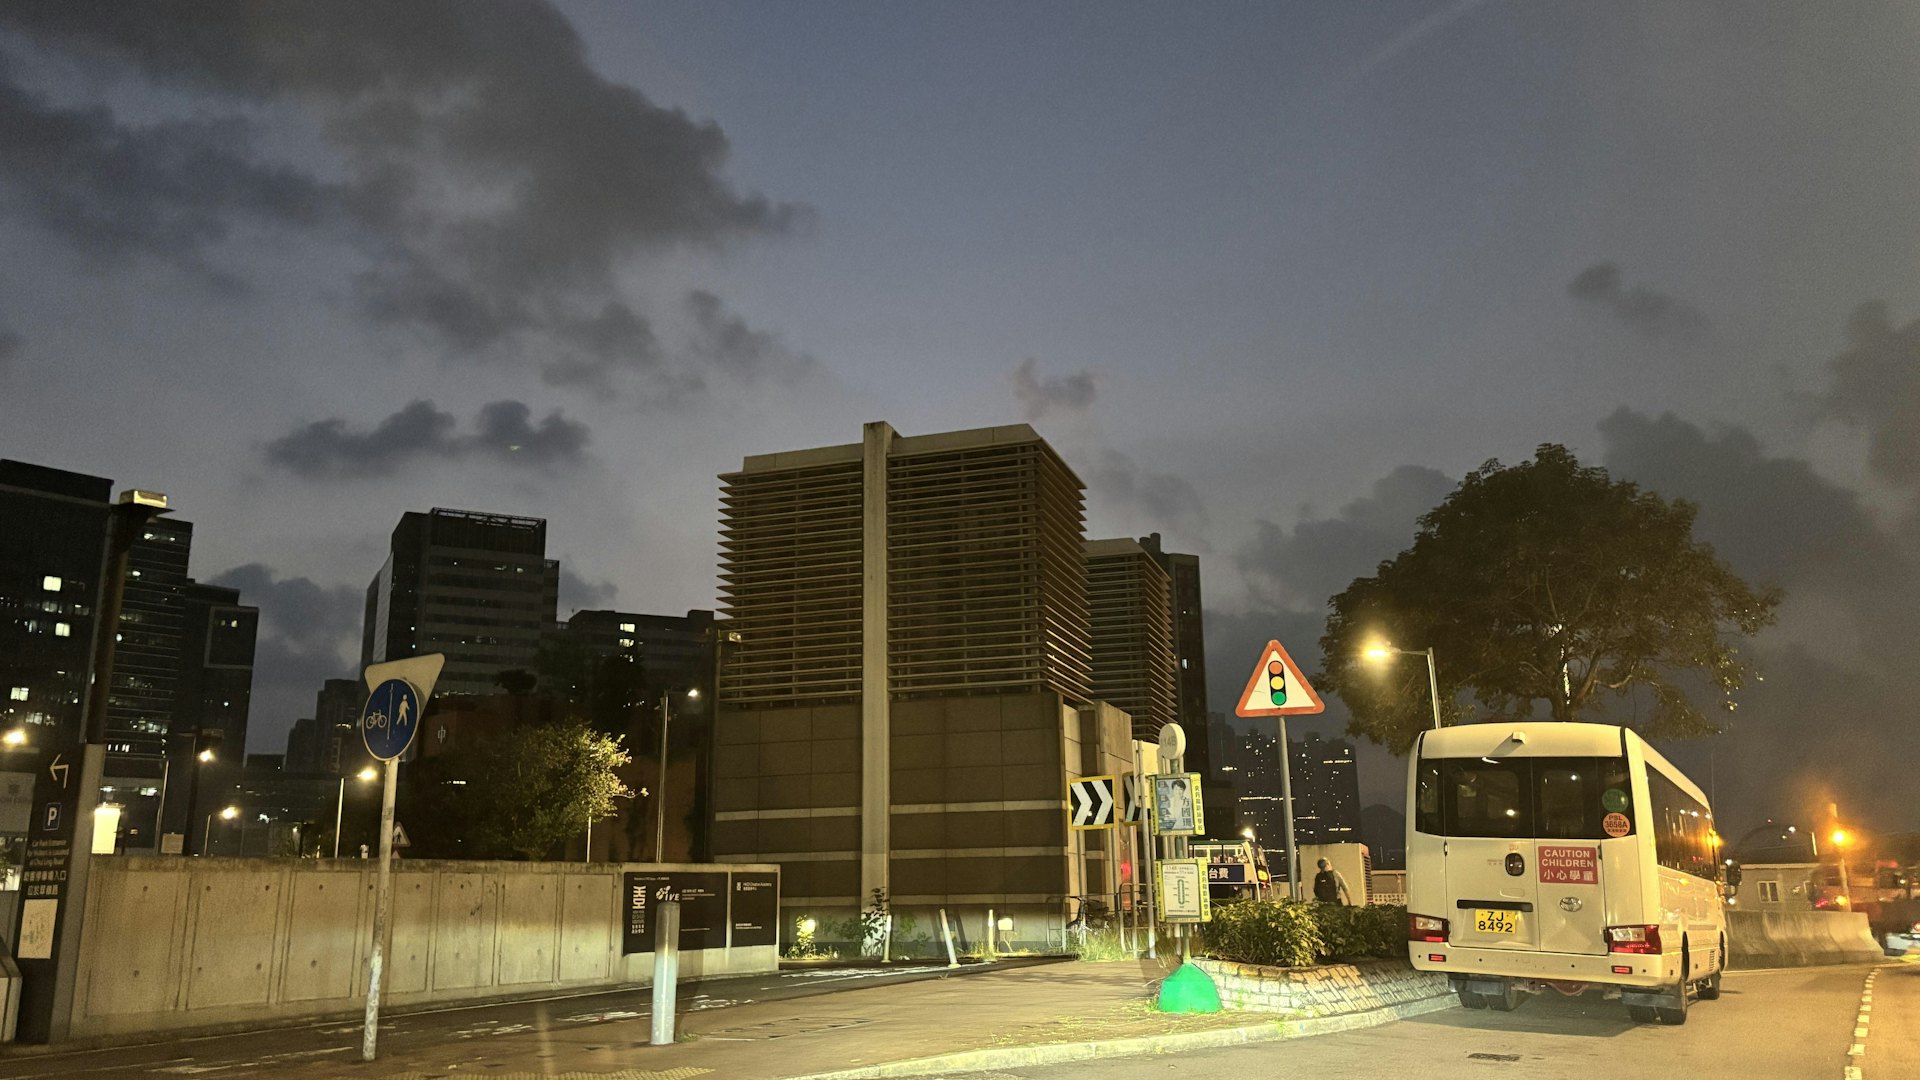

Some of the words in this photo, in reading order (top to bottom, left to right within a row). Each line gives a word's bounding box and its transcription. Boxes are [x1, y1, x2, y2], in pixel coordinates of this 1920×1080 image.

[48, 807, 57, 826] P
[1544, 849, 1590, 858] CAUTION
[1541, 859, 1594, 868] CHILDREN
[1209, 867, 1229, 879] 台費
[1543, 869, 1594, 882] 小心學童
[664, 893, 680, 901] IVE
[1487, 911, 1504, 921] ZJ
[1478, 921, 1513, 933] 8492
